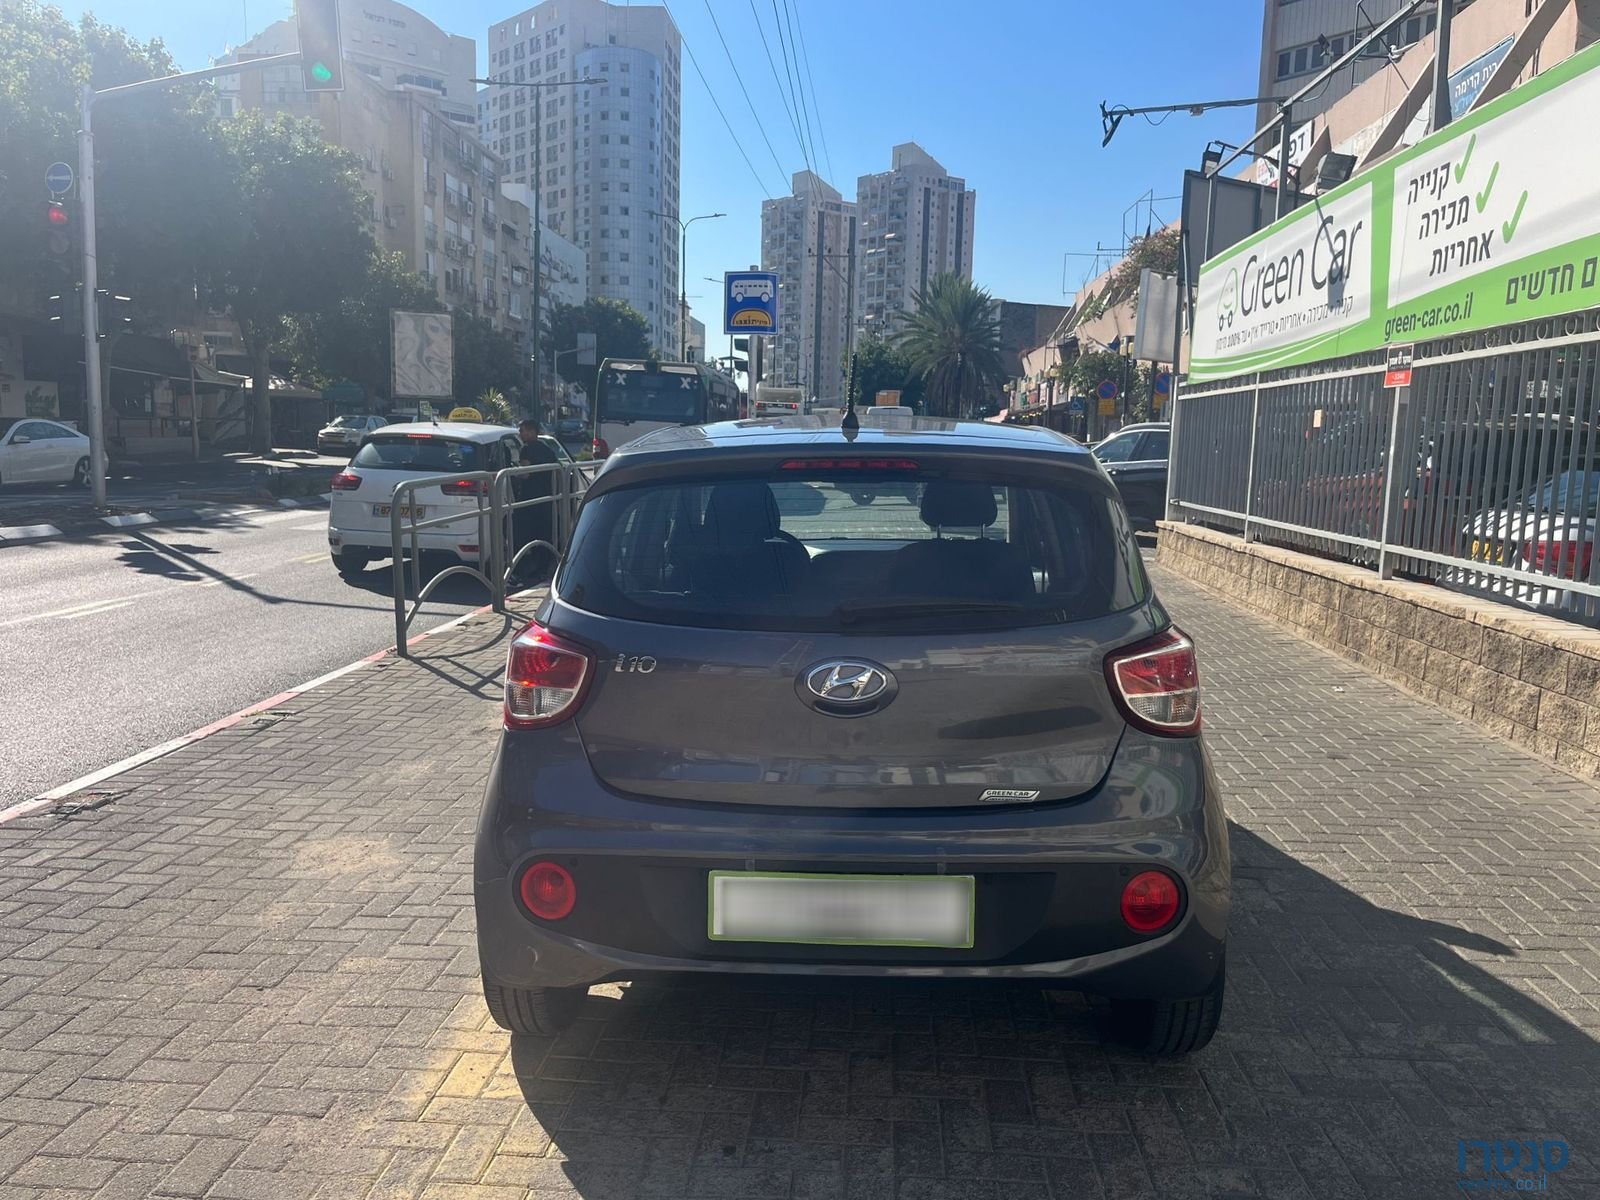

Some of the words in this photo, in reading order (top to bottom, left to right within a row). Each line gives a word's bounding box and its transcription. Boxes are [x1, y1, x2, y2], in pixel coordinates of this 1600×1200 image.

[1455, 71, 1480, 98] קדימה
[1407, 161, 1451, 206] קנייה
[1418, 194, 1470, 241] מכירה
[1241, 248, 1305, 317] Green
[1311, 215, 1363, 291] Car
[1428, 228, 1495, 277] אחריות
[1505, 262, 1575, 306] חדשים
[1279, 312, 1303, 333] אחריות
[1307, 303, 1329, 325] מכירה
[1384, 291, 1474, 342] green-car.co.il
[614, 653, 657, 674] i10
